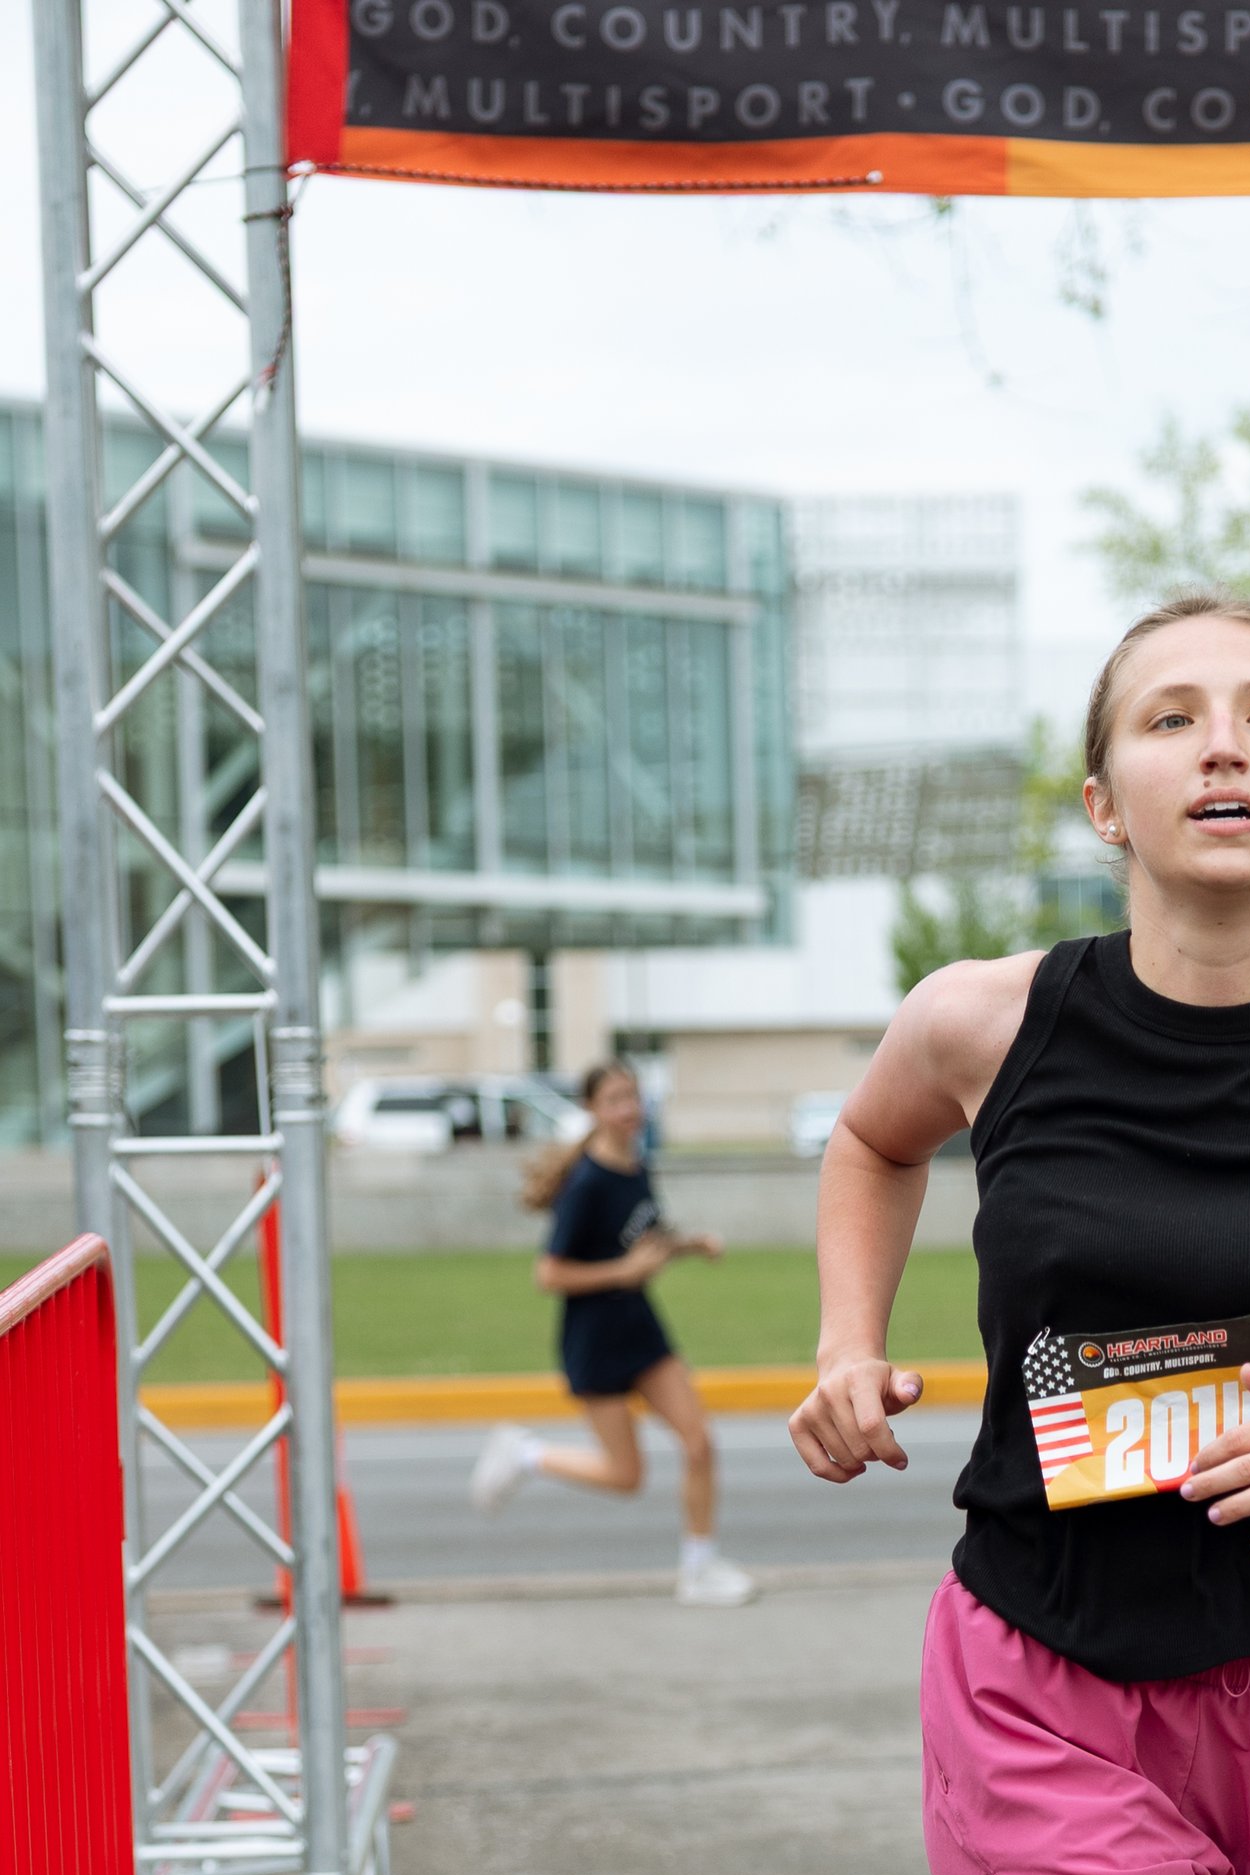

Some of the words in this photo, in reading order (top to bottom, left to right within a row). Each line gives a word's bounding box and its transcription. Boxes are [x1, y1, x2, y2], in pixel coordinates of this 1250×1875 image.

[402, 76, 875, 130] MULTISPORT
[1106, 1328, 1228, 1359] HEARTLAND
[1123, 1361, 1163, 1377] COUNTRY.
[1164, 1353, 1217, 1369] MULTISPORT.
